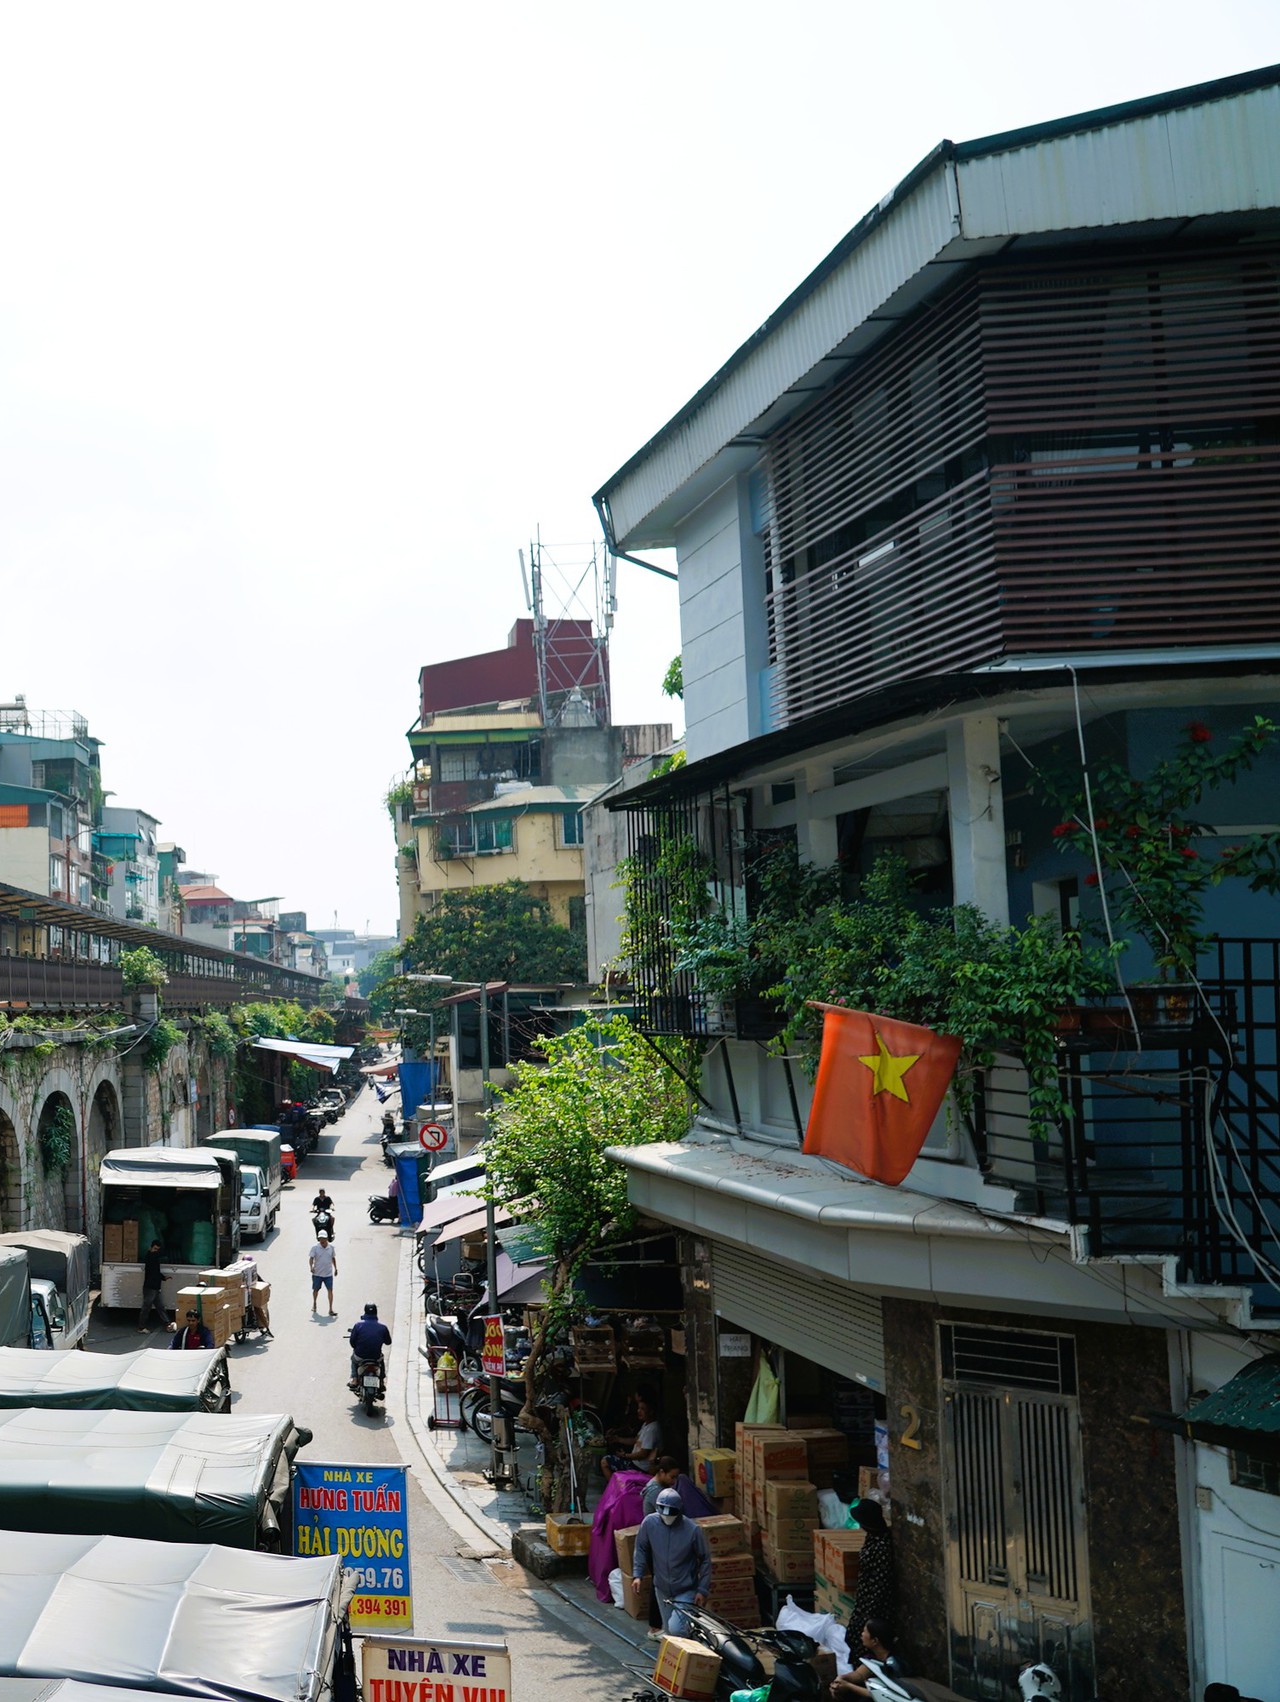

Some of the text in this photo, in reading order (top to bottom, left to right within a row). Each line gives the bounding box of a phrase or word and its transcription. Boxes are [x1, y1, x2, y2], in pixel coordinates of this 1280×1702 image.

[900, 1405, 922, 1451] 2
[323, 1469, 373, 1483] NHÀ XE
[300, 1483, 401, 1513] HƯNG TUẤN
[298, 1514, 403, 1558] HẢI DƯƠNG
[384, 1599, 406, 1616] 391
[388, 1648, 487, 1678] NHÀ XE
